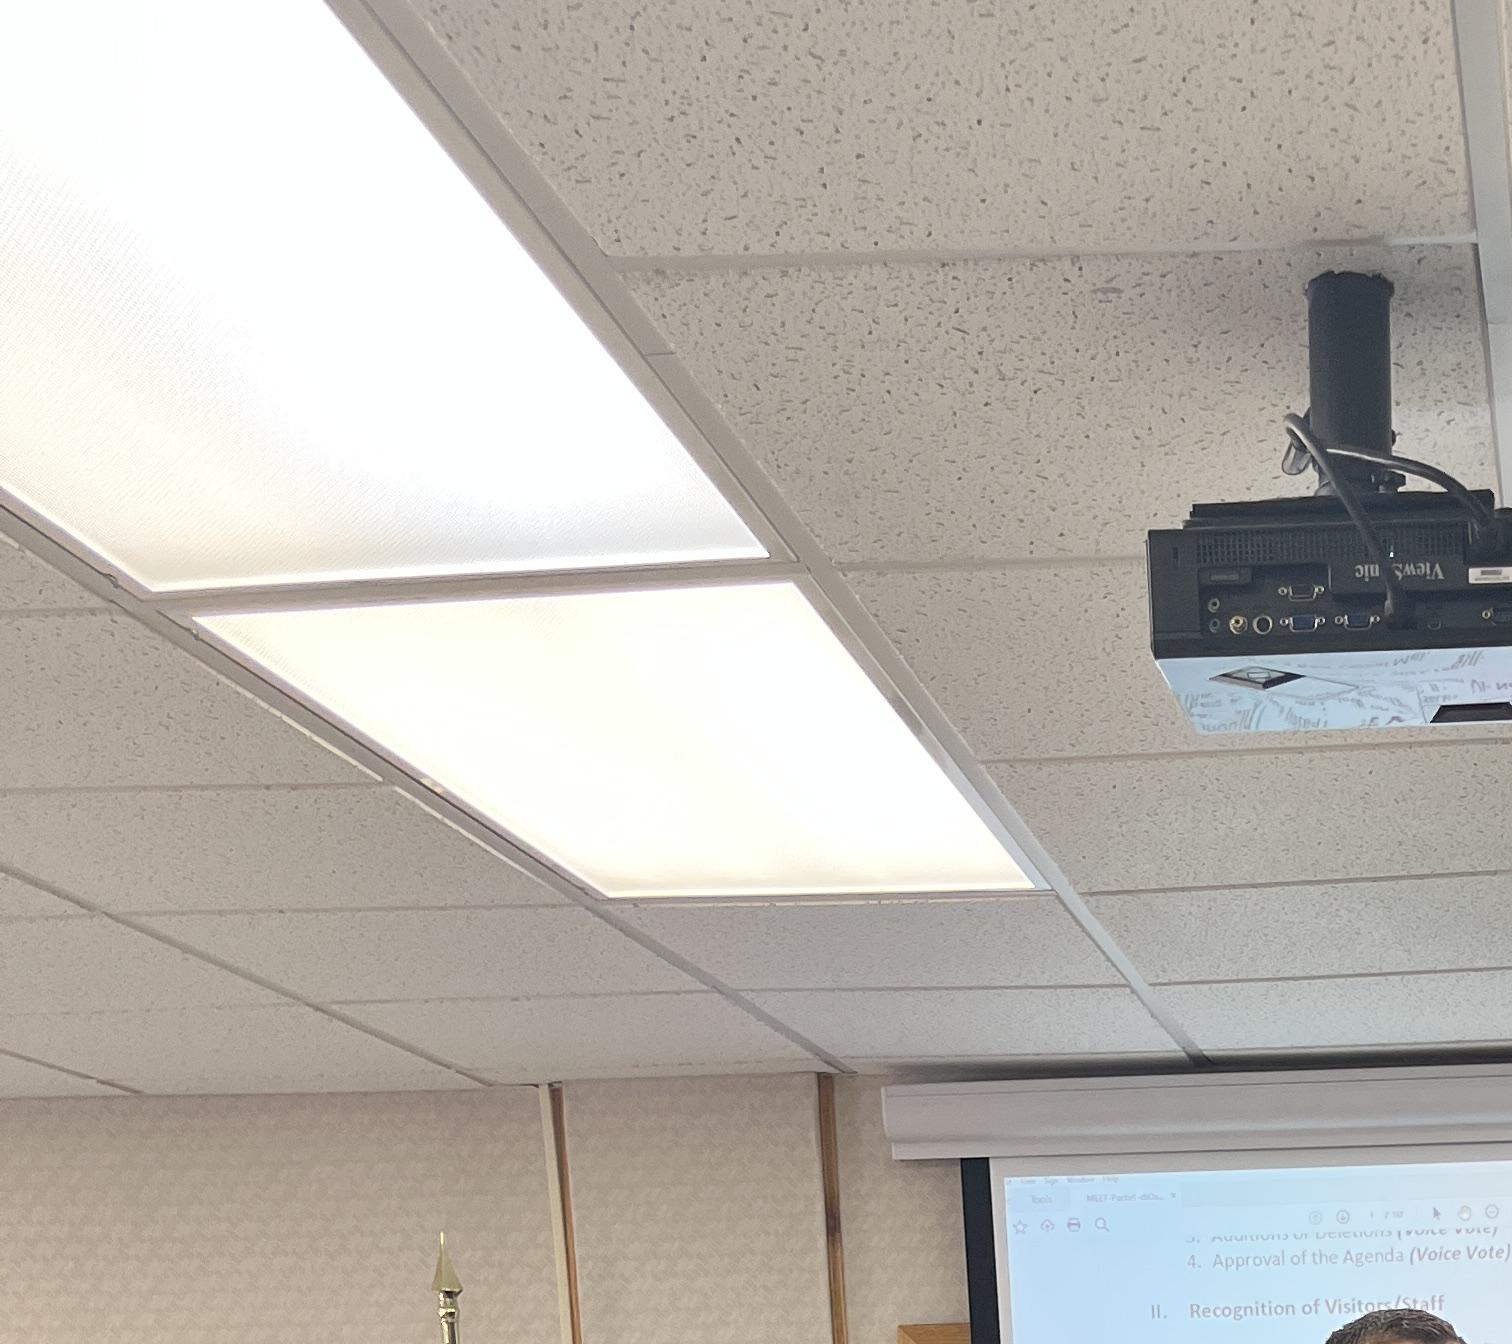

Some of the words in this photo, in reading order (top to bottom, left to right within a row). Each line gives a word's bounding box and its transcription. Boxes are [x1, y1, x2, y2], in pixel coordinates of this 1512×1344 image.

[1354, 562, 1444, 581] ViewSnic
[1187, 1254, 1201, 1269] 4.
[1212, 1250, 1285, 1271] Approval
[1290, 1249, 1308, 1266] of
[1313, 1249, 1338, 1265] the
[1342, 1248, 1404, 1268] Agenda
[1409, 1247, 1461, 1265] (Voice
[1466, 1243, 1512, 1262] Vote)
[1151, 1304, 1167, 1320] II.
[1190, 1300, 1296, 1320] Recognition
[1300, 1298, 1321, 1315] of
